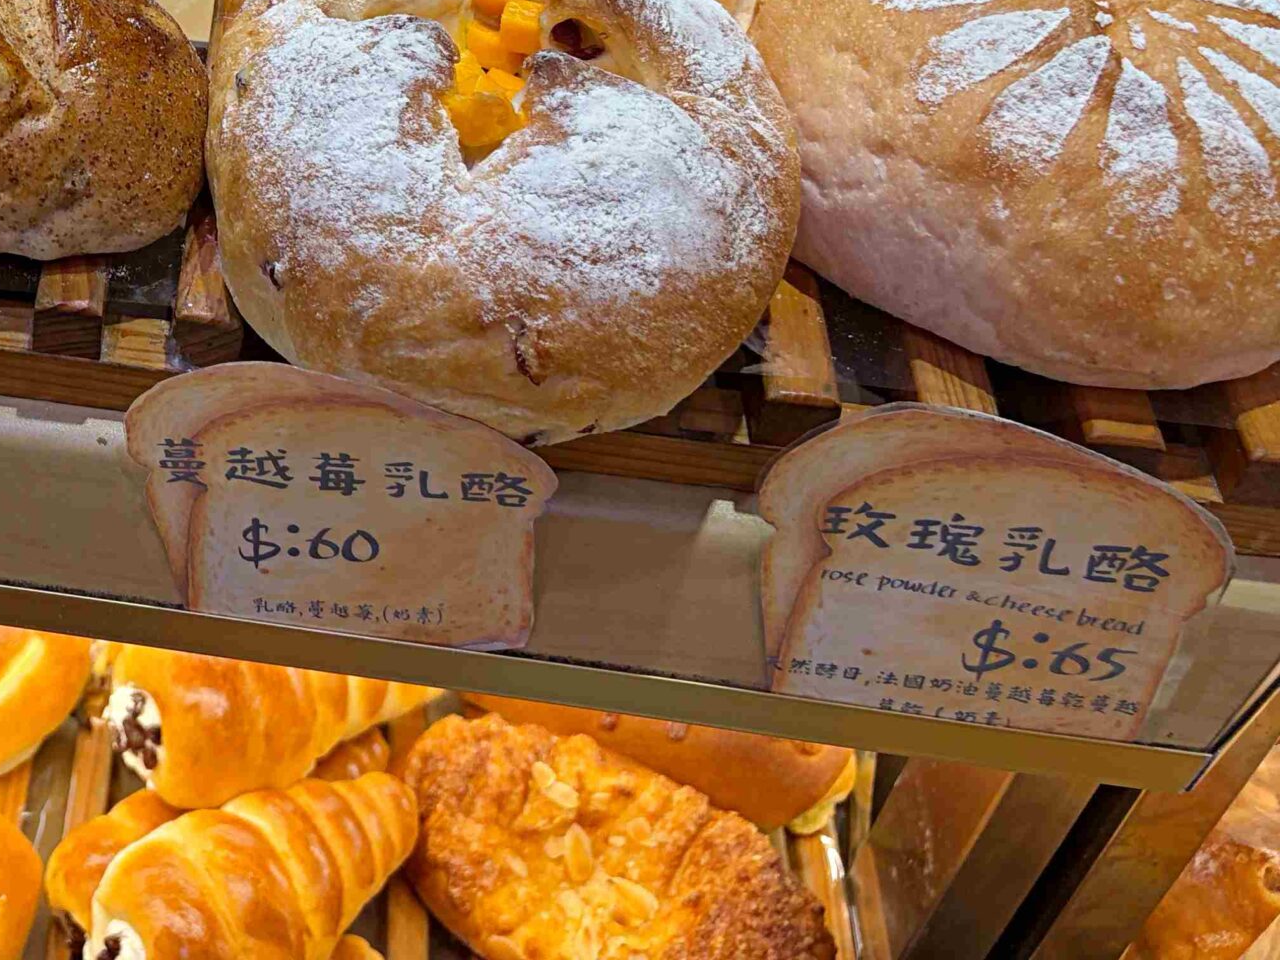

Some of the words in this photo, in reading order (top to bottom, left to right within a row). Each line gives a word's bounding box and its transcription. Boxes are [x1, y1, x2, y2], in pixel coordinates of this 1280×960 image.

[157, 438, 534, 508] 蔓越莓乳酪
[821, 502, 1170, 593] 玫瑰乳酪
[820, 568, 869, 586] rose
[877, 575, 958, 599] powder
[1076, 608, 1145, 636] bread
